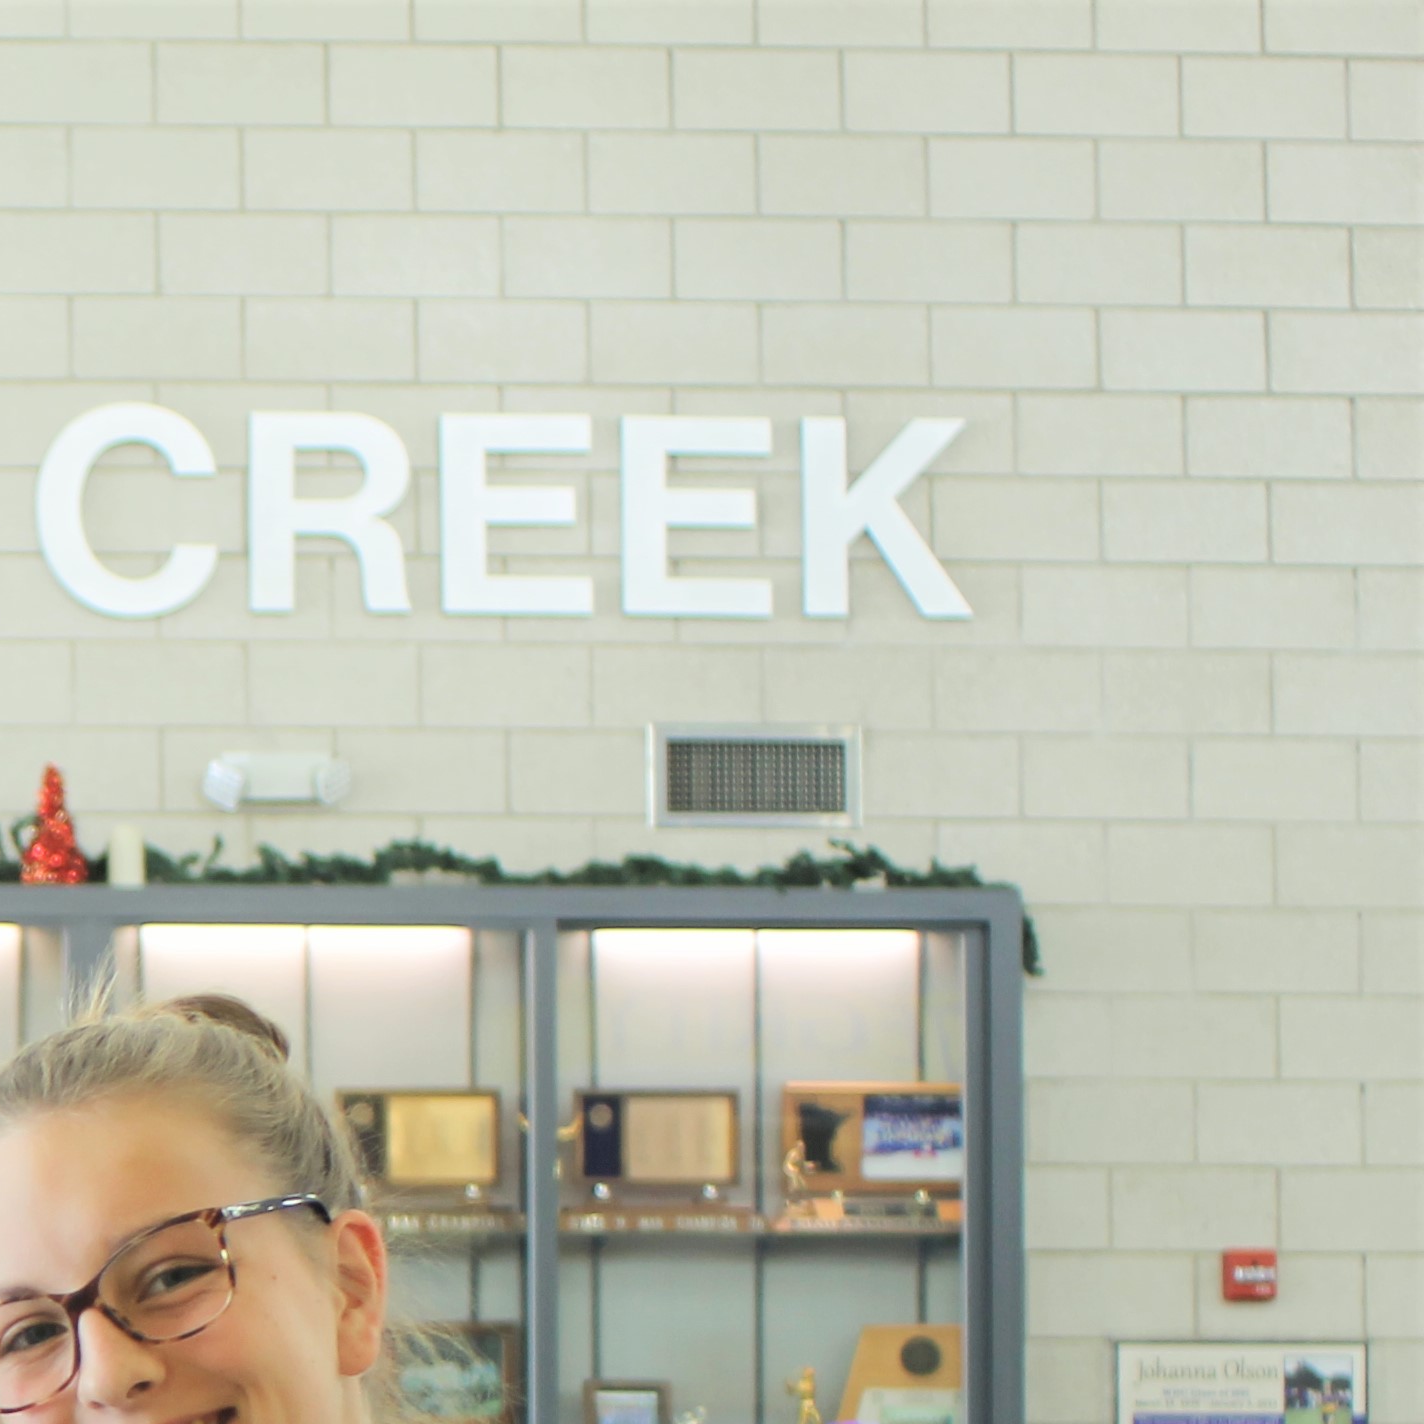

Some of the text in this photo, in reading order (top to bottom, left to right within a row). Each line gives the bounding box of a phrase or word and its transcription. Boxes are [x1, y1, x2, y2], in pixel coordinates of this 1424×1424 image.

[34, 400, 975, 622] CREEK
[1134, 1356, 1279, 1387] Johanna Olson
